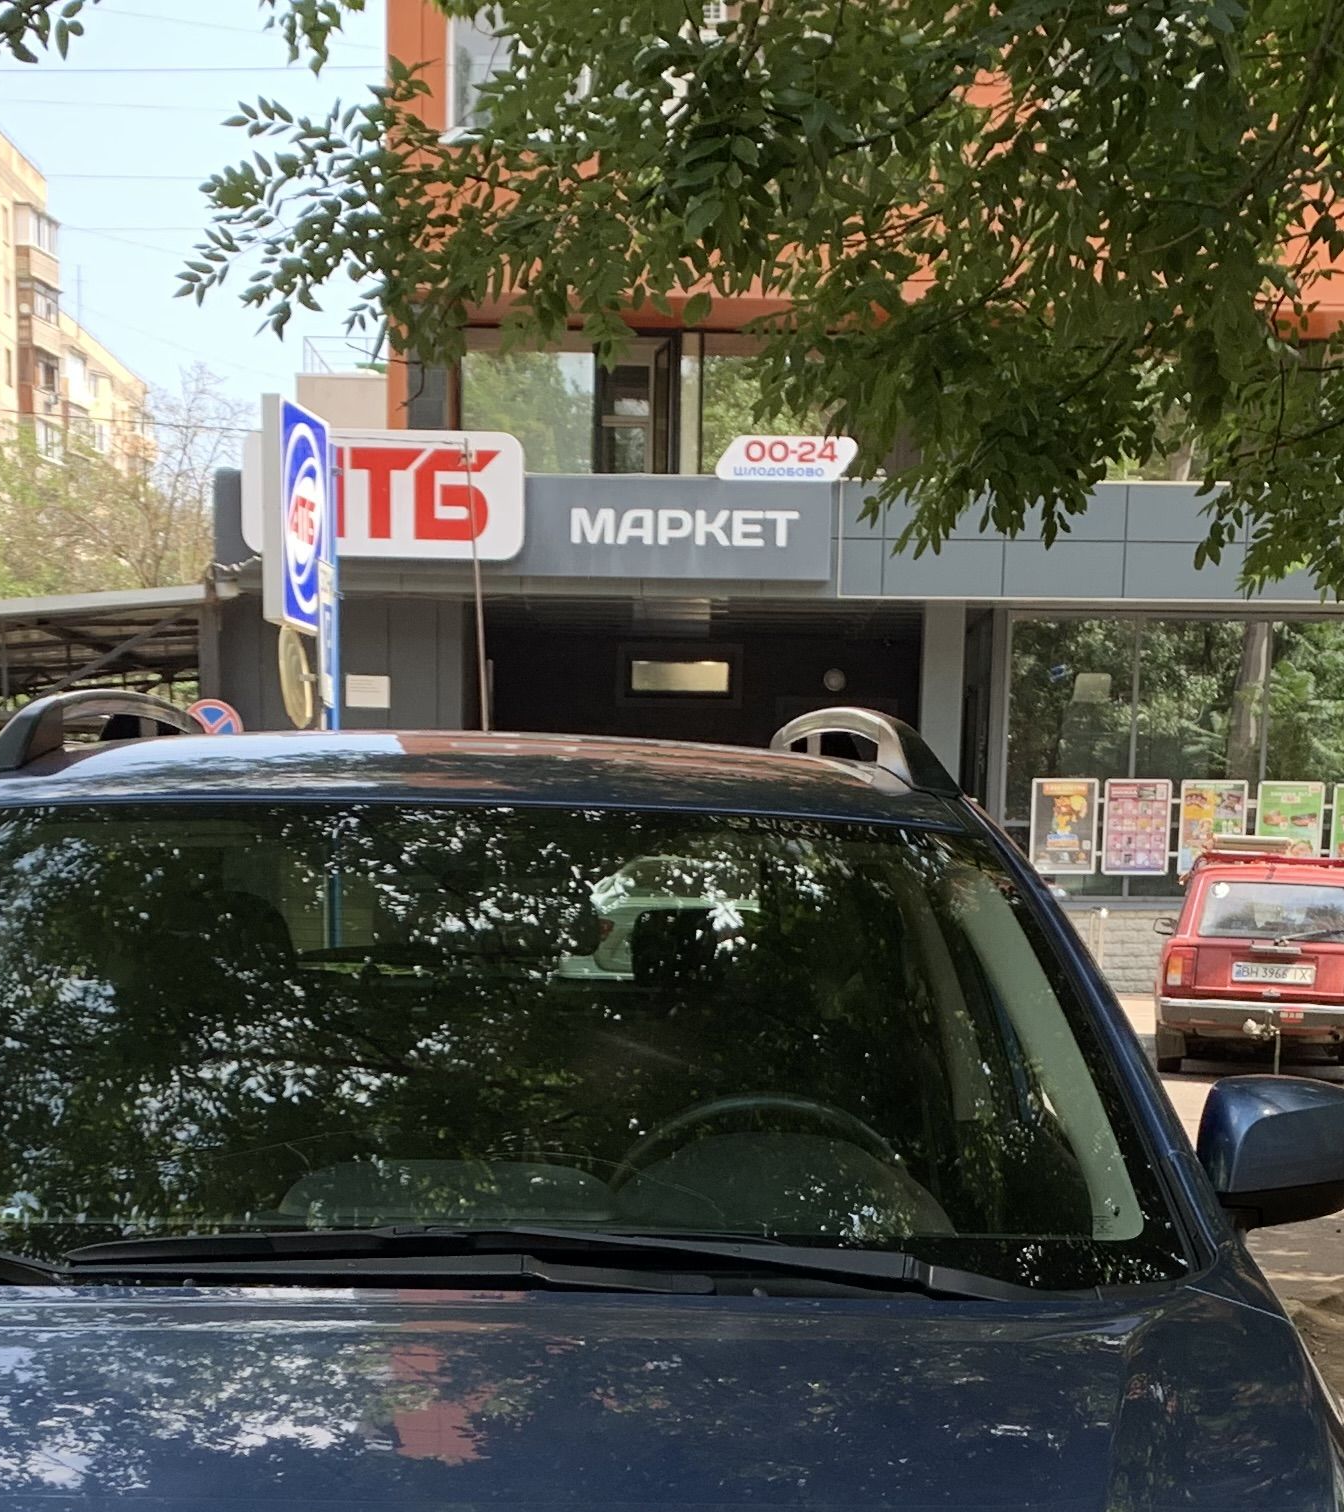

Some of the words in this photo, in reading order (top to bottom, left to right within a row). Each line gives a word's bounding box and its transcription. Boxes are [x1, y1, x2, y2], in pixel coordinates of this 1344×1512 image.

[745, 440, 838, 462] 00-24
[336, 447, 501, 540] ТБ
[570, 508, 800, 548] МАРКЕТ
